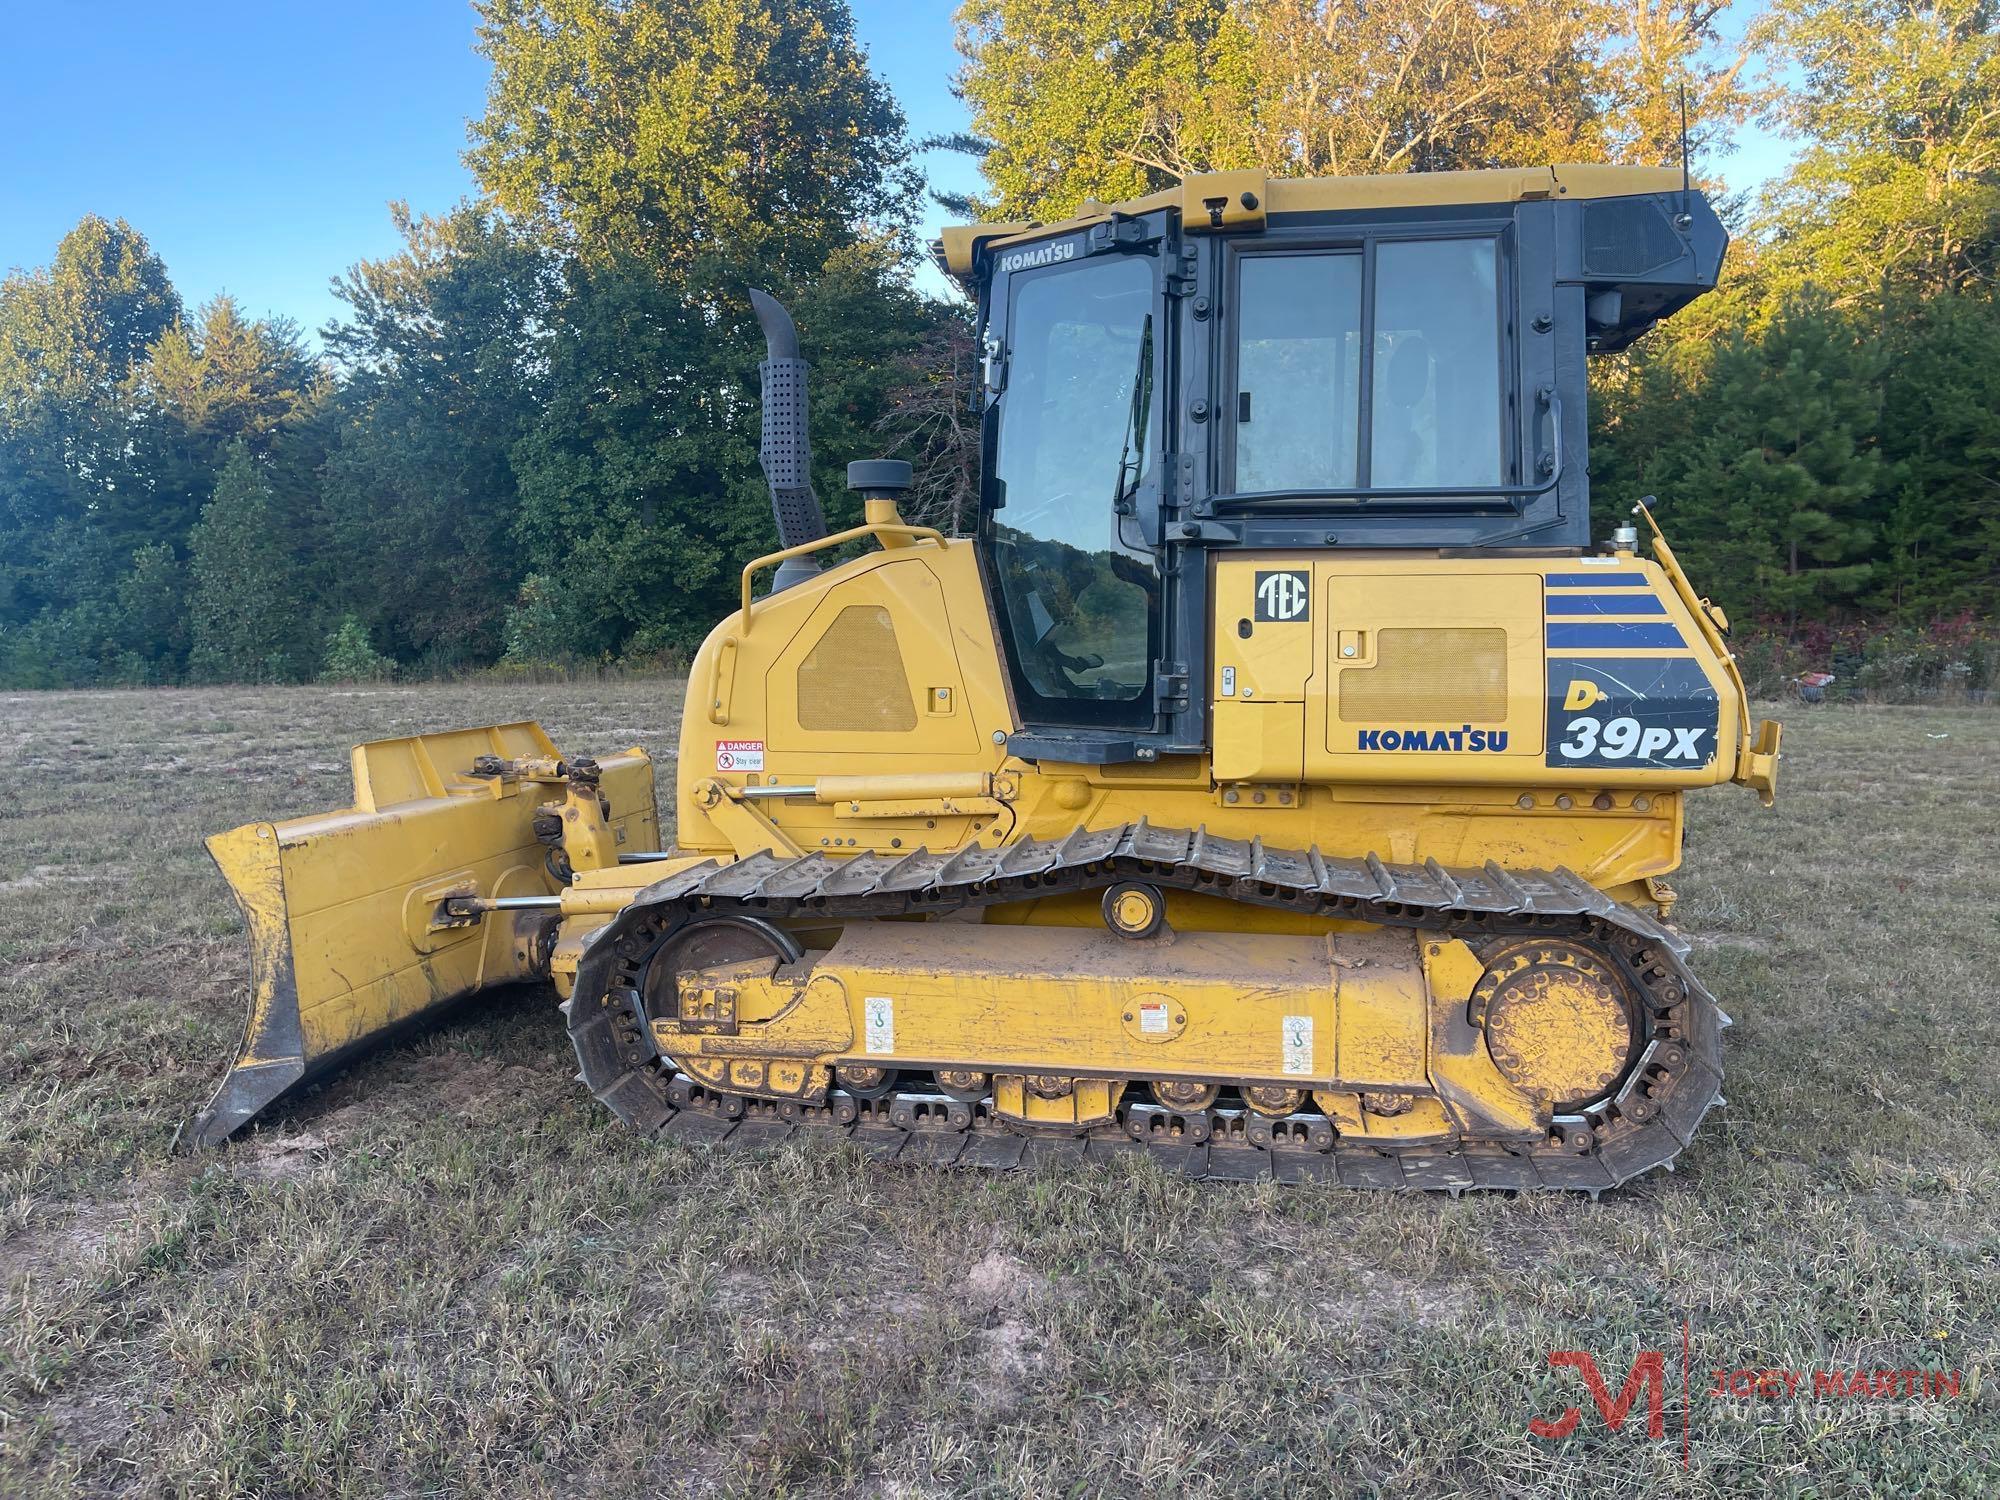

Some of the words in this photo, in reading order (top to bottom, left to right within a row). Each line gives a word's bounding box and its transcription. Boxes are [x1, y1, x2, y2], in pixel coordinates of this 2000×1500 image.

[1001, 242, 1074, 272] KOMATSU
[1563, 680, 1600, 711] D
[727, 742, 763, 750] DANGER
[1358, 724, 1508, 752] KOMATSU
[1560, 716, 1707, 759] 39PX
[736, 757, 747, 766] Stay
